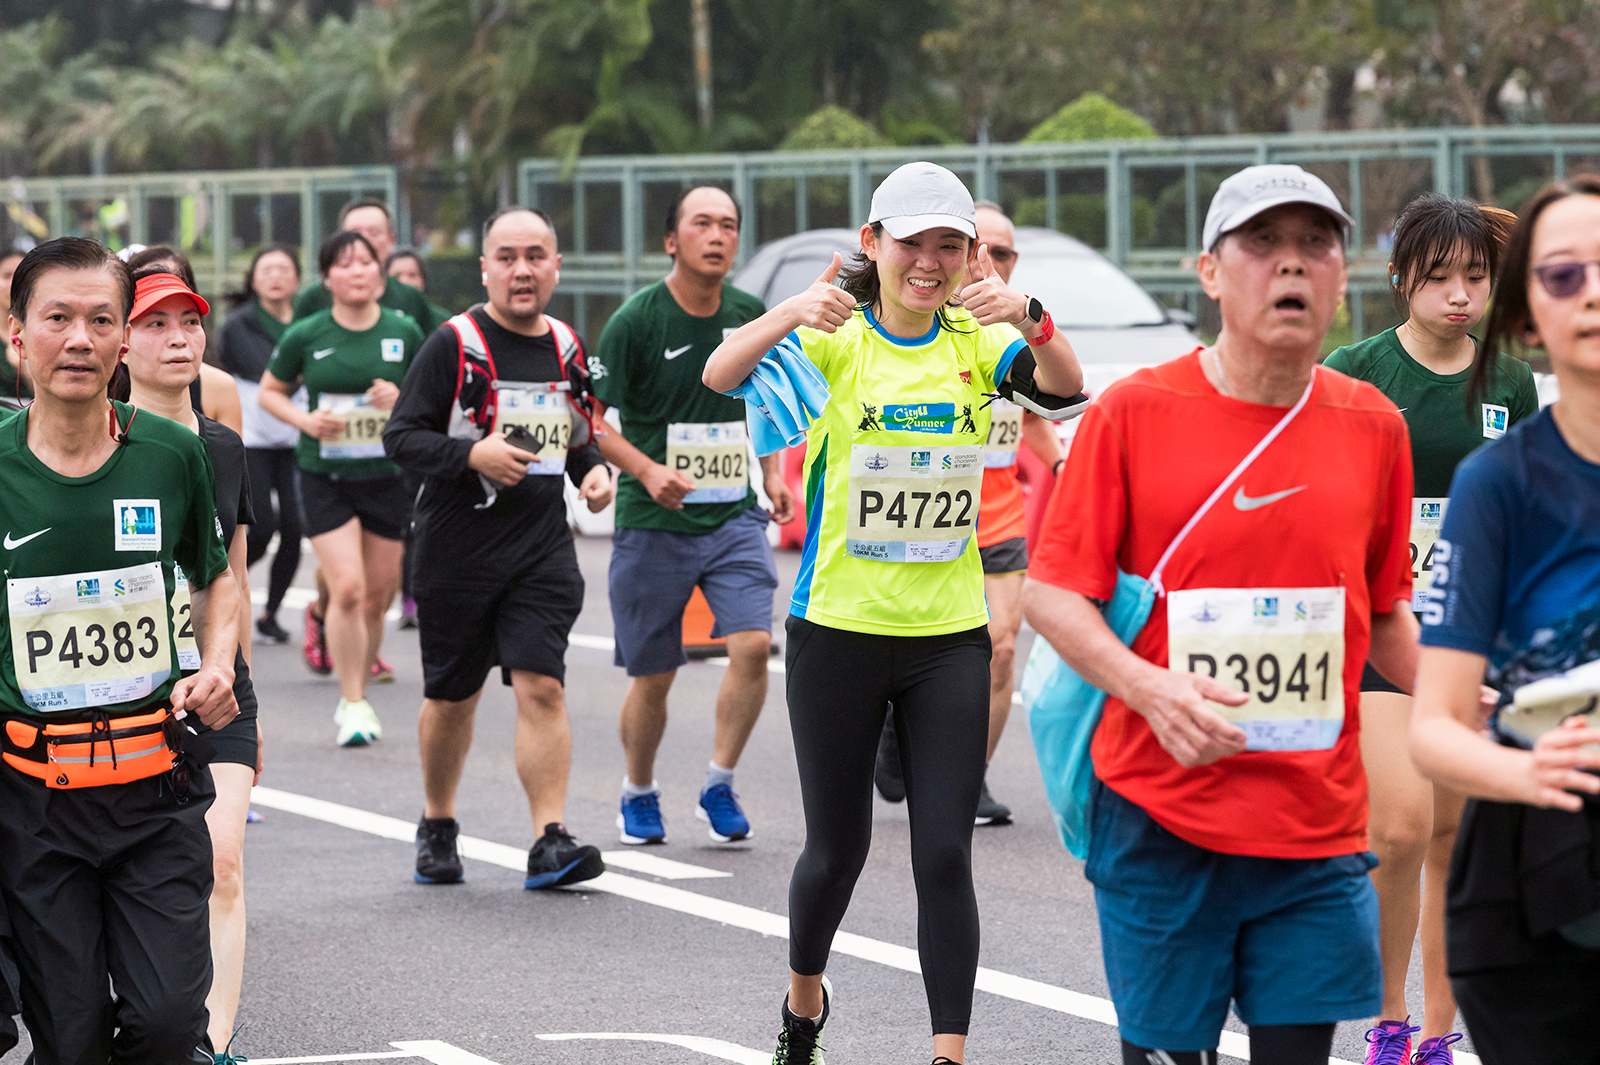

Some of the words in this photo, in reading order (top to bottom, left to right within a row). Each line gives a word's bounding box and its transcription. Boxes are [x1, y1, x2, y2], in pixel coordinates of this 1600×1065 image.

[894, 405, 928, 422] CityU
[902, 417, 946, 430] Runner
[675, 453, 743, 479] P3402
[859, 489, 973, 529] P4722
[26, 616, 159, 673] P4383
